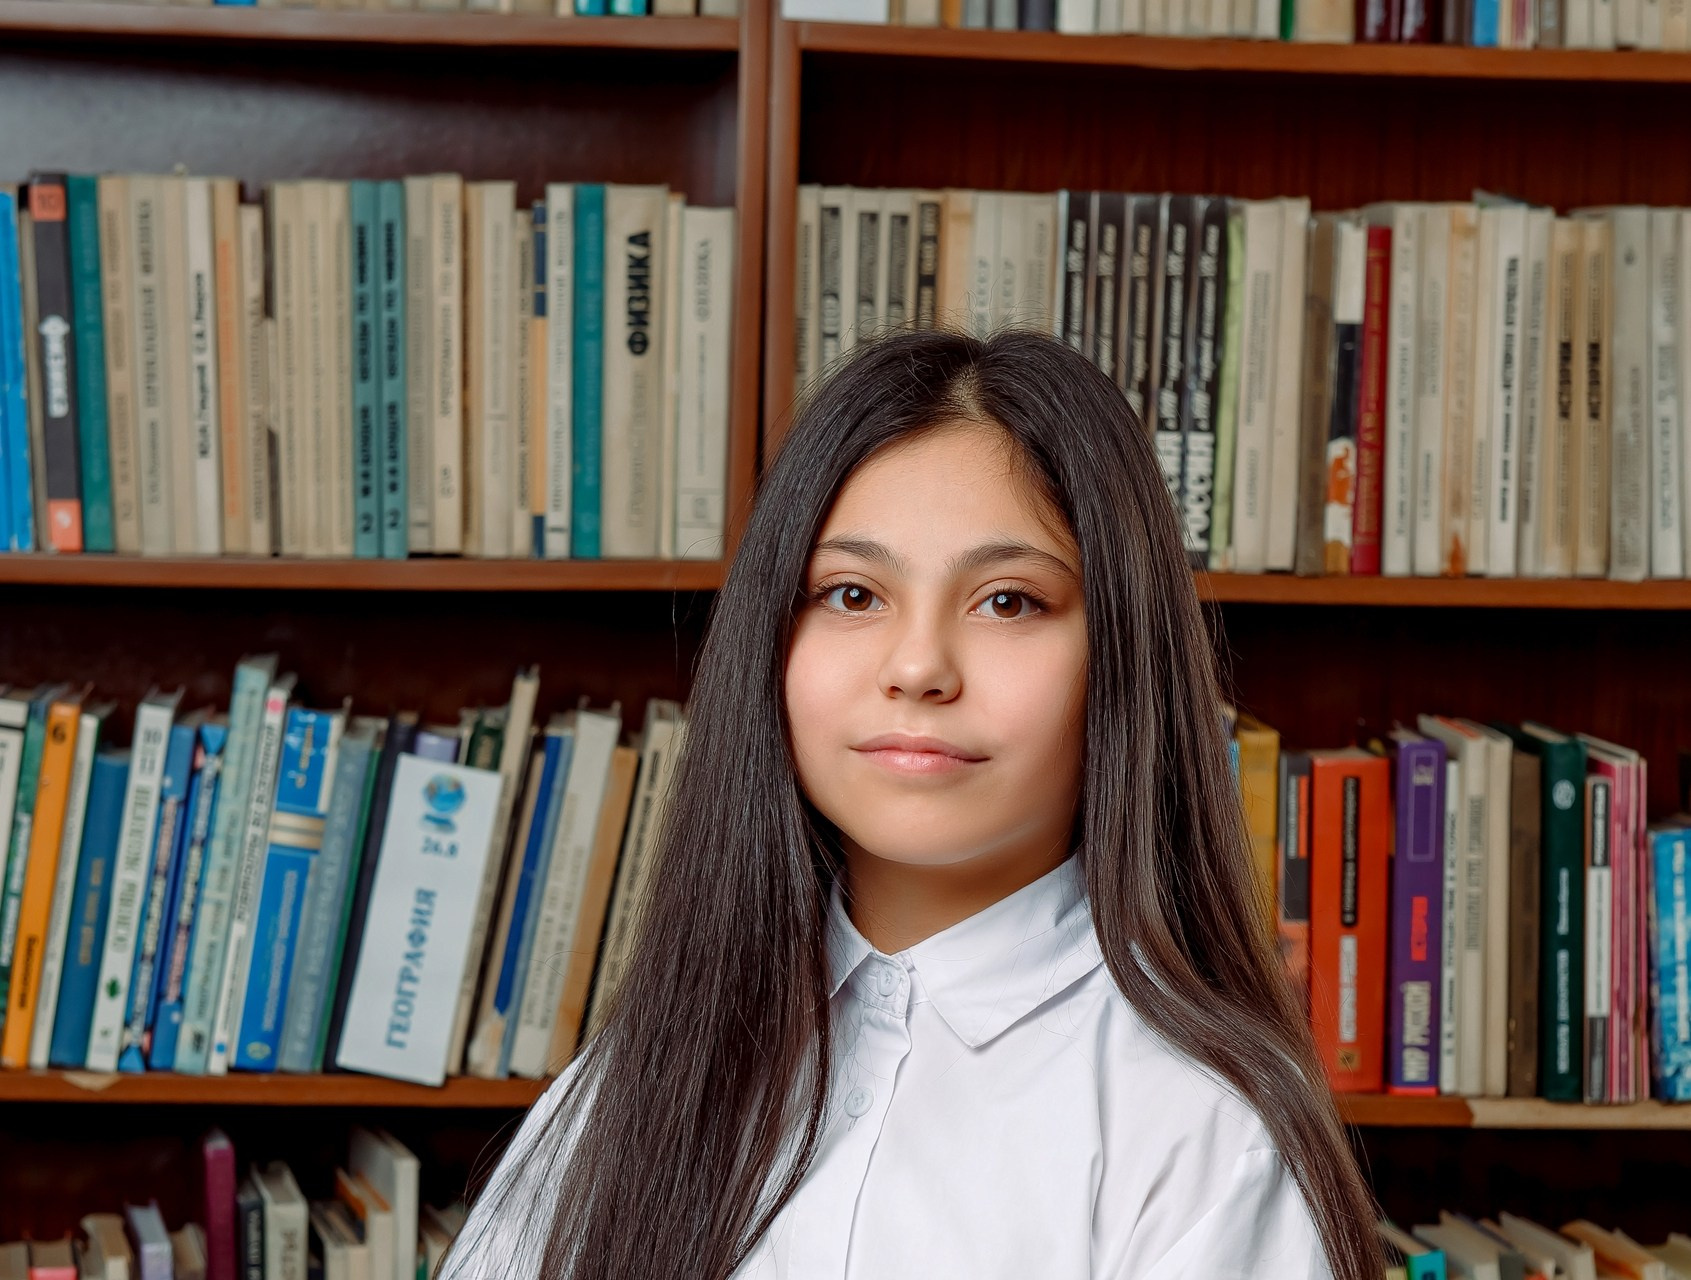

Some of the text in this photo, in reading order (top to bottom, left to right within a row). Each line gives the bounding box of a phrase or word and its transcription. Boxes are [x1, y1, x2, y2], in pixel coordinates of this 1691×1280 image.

[626, 229, 653, 356] ФИЗИКА
[1184, 430, 1215, 551] РОССИЯ
[385, 887, 437, 1050] ГЕОГРАФИЯ
